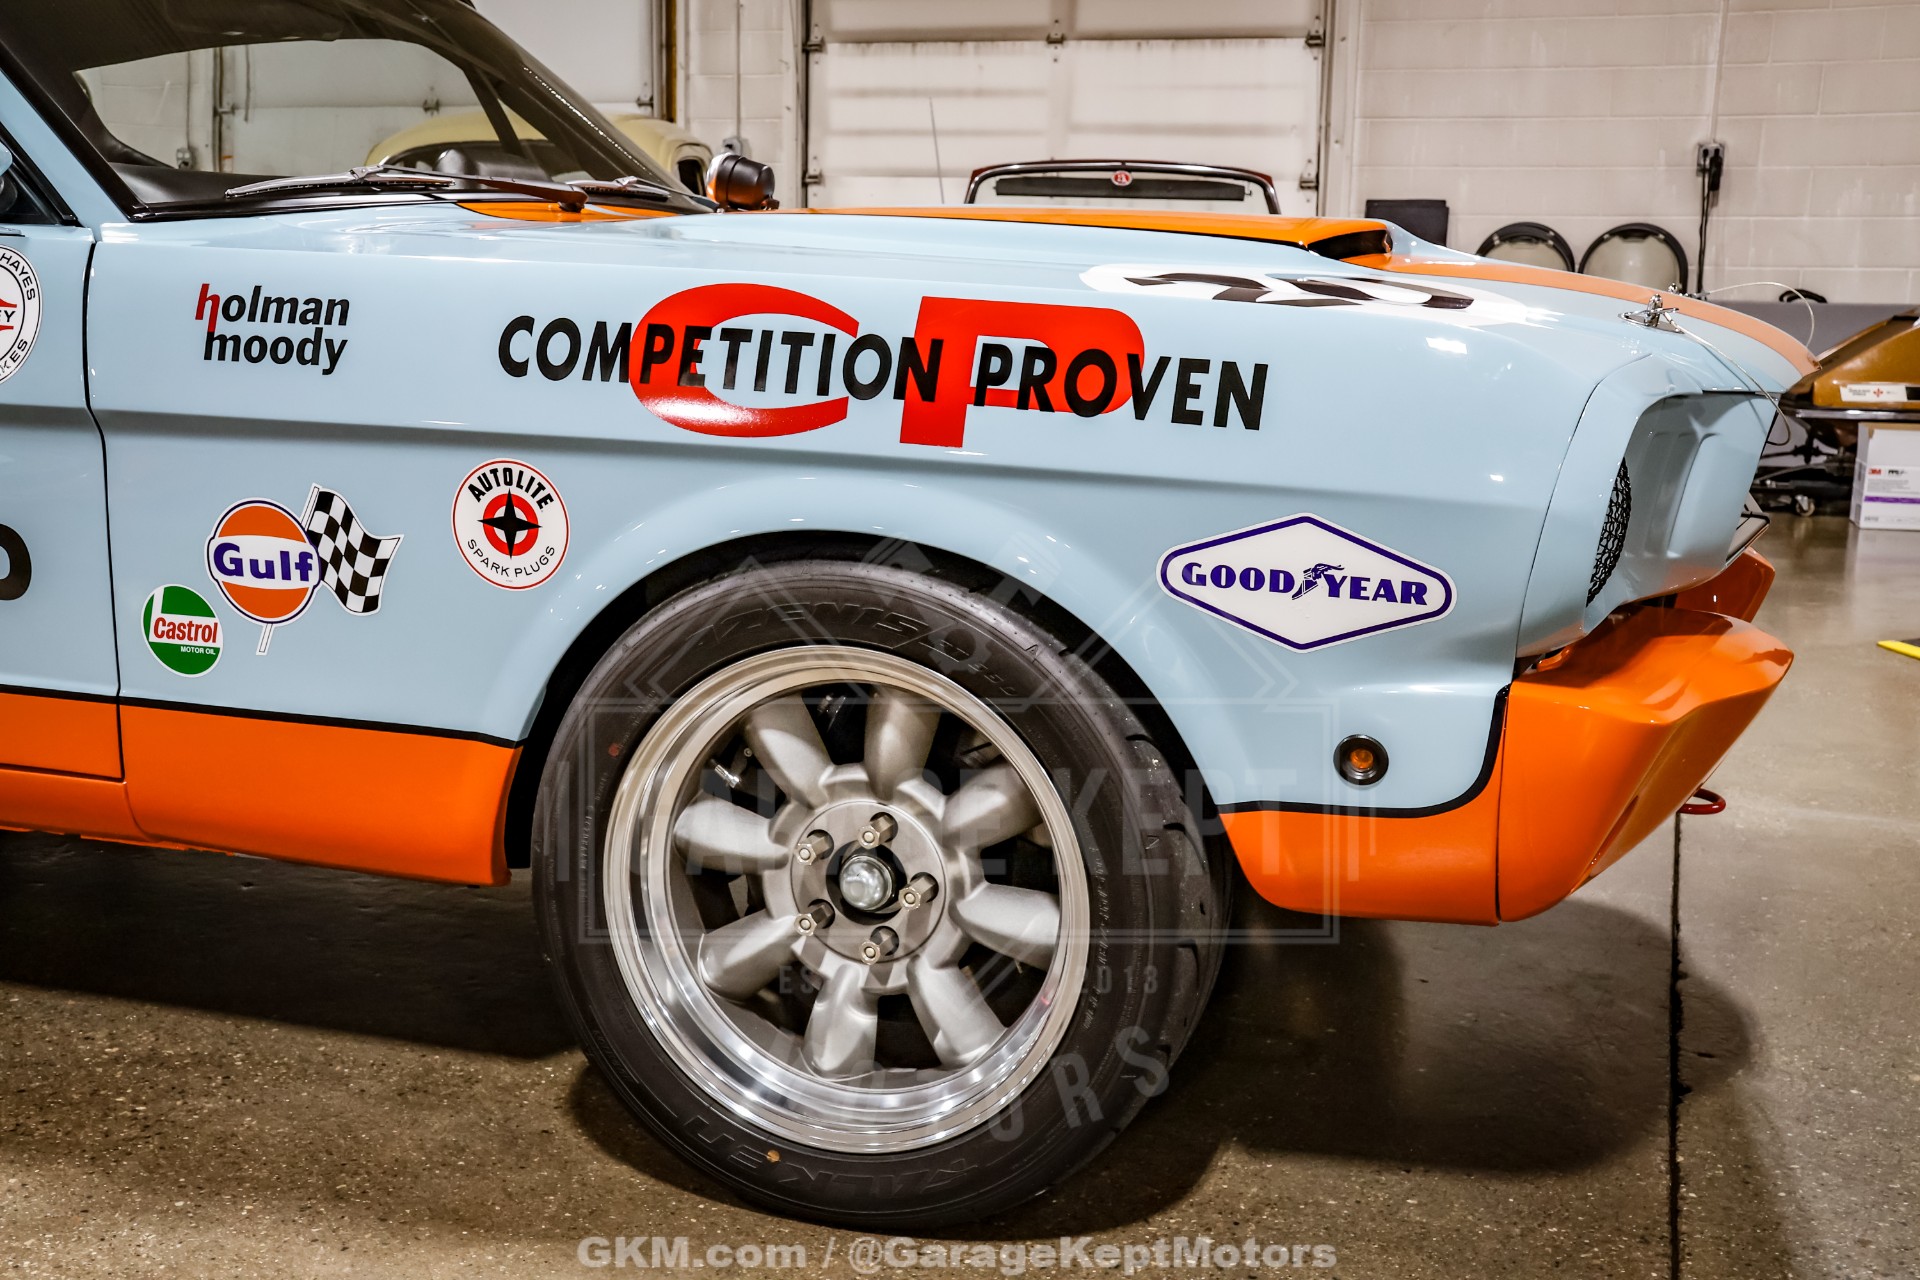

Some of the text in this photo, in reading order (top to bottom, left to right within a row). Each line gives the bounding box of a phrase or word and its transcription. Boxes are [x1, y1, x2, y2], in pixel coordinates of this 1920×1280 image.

[1, 253, 36, 300] HAYES
[195, 283, 350, 332] holman
[203, 326, 349, 376] moody
[498, 315, 1269, 431] COMPETITION PROVEN
[467, 467, 555, 510] AUTOLITE
[213, 542, 314, 582] Gulf
[467, 538, 556, 578] SPARK PLUGS
[153, 617, 219, 643] Castrol
[180, 645, 205, 654] MOTOR
